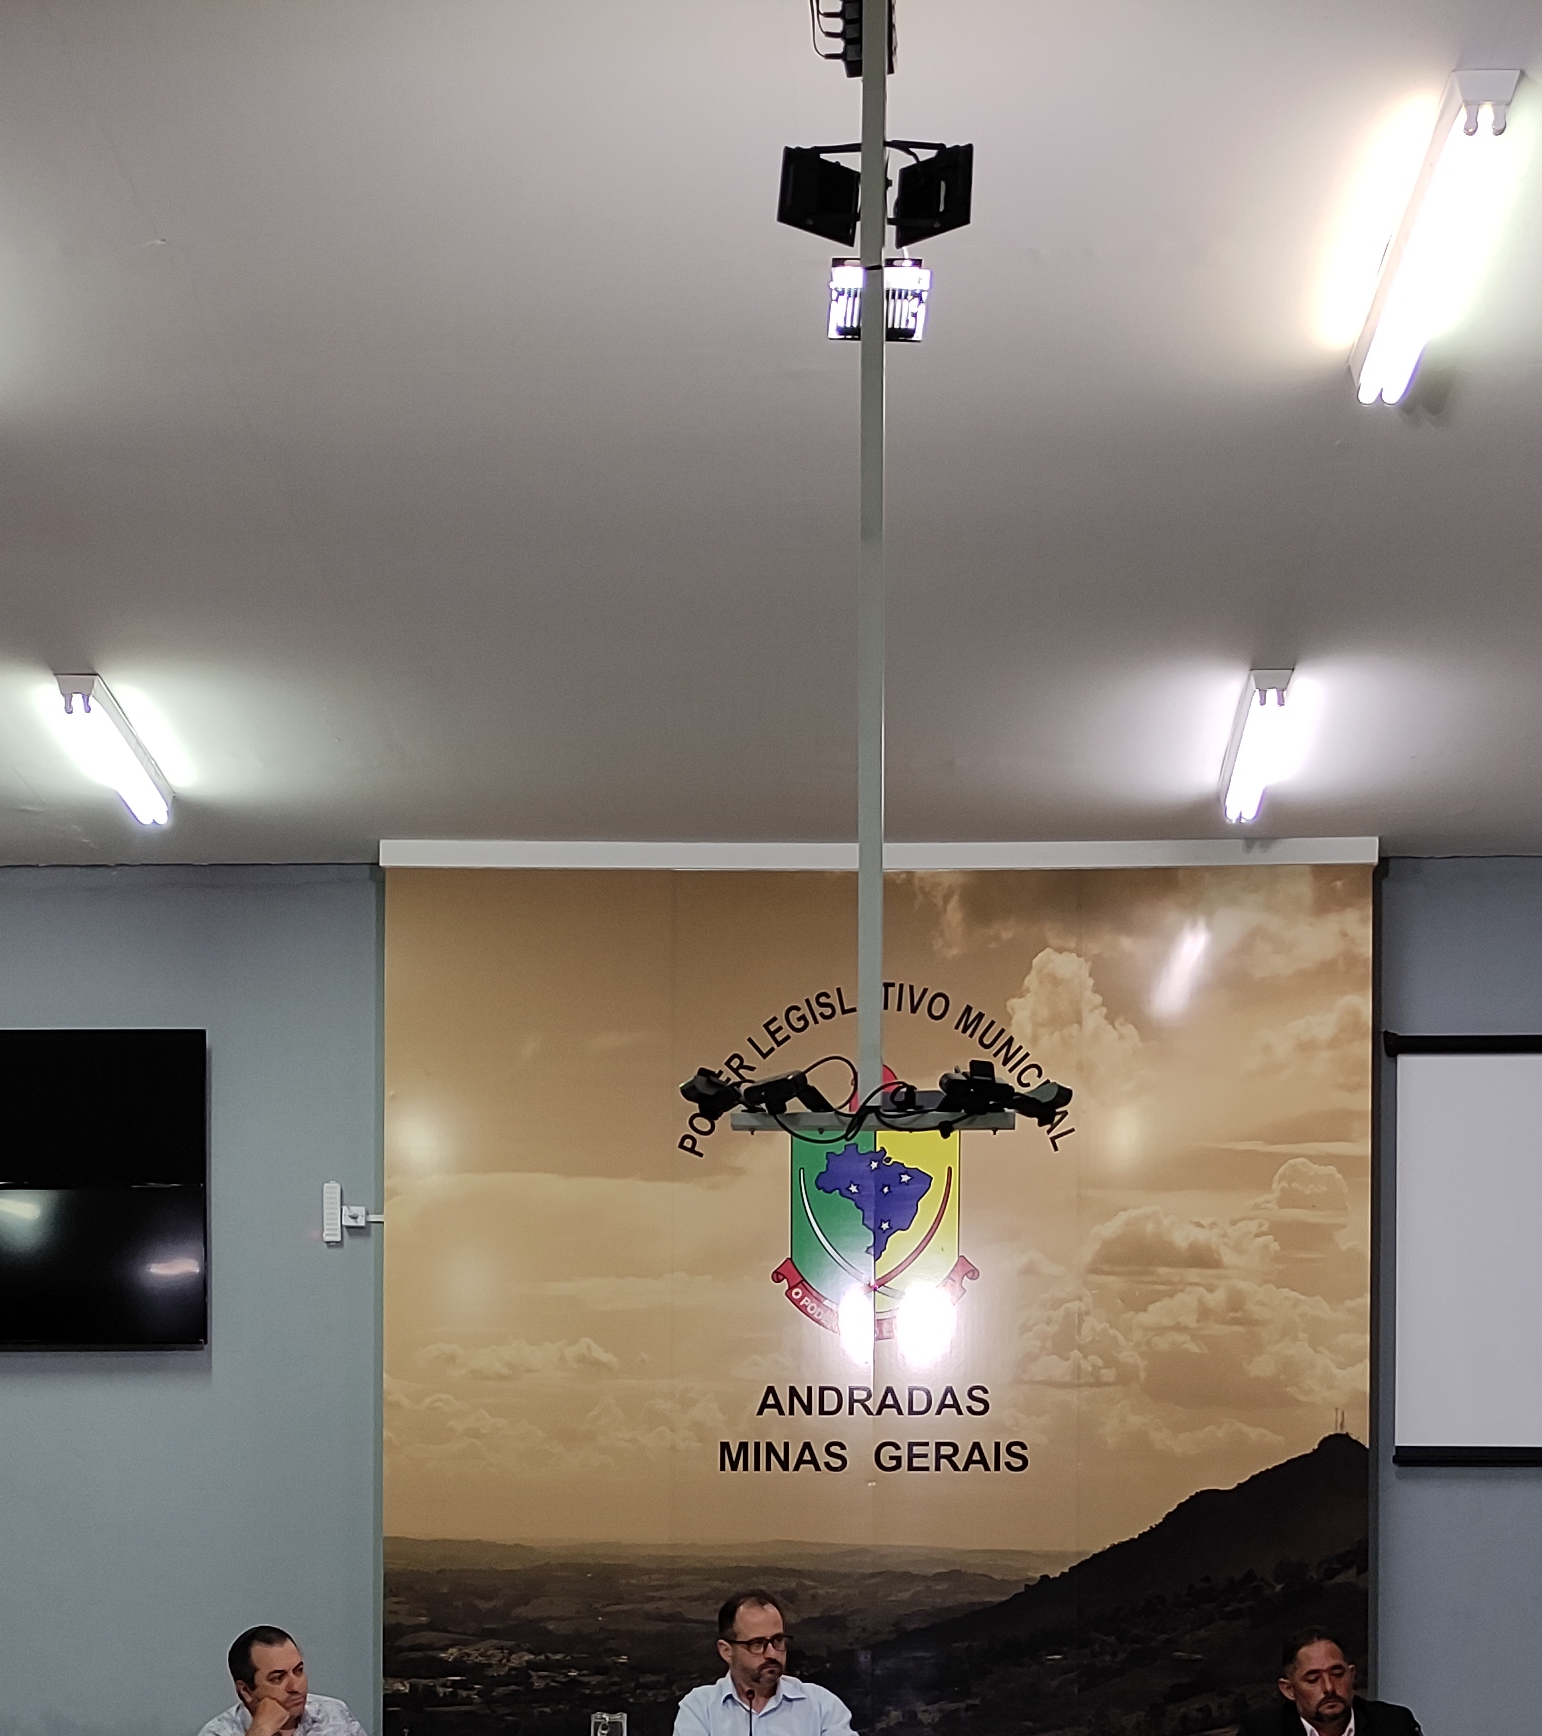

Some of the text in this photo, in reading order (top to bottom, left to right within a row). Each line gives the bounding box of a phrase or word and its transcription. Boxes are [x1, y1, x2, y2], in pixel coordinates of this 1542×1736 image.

[677, 982, 1076, 1159] POR LEGISLTIVO MUNICAL
[756, 1384, 991, 1416] ANDRADAS
[718, 1440, 1030, 1473] MINAS GERAIS
